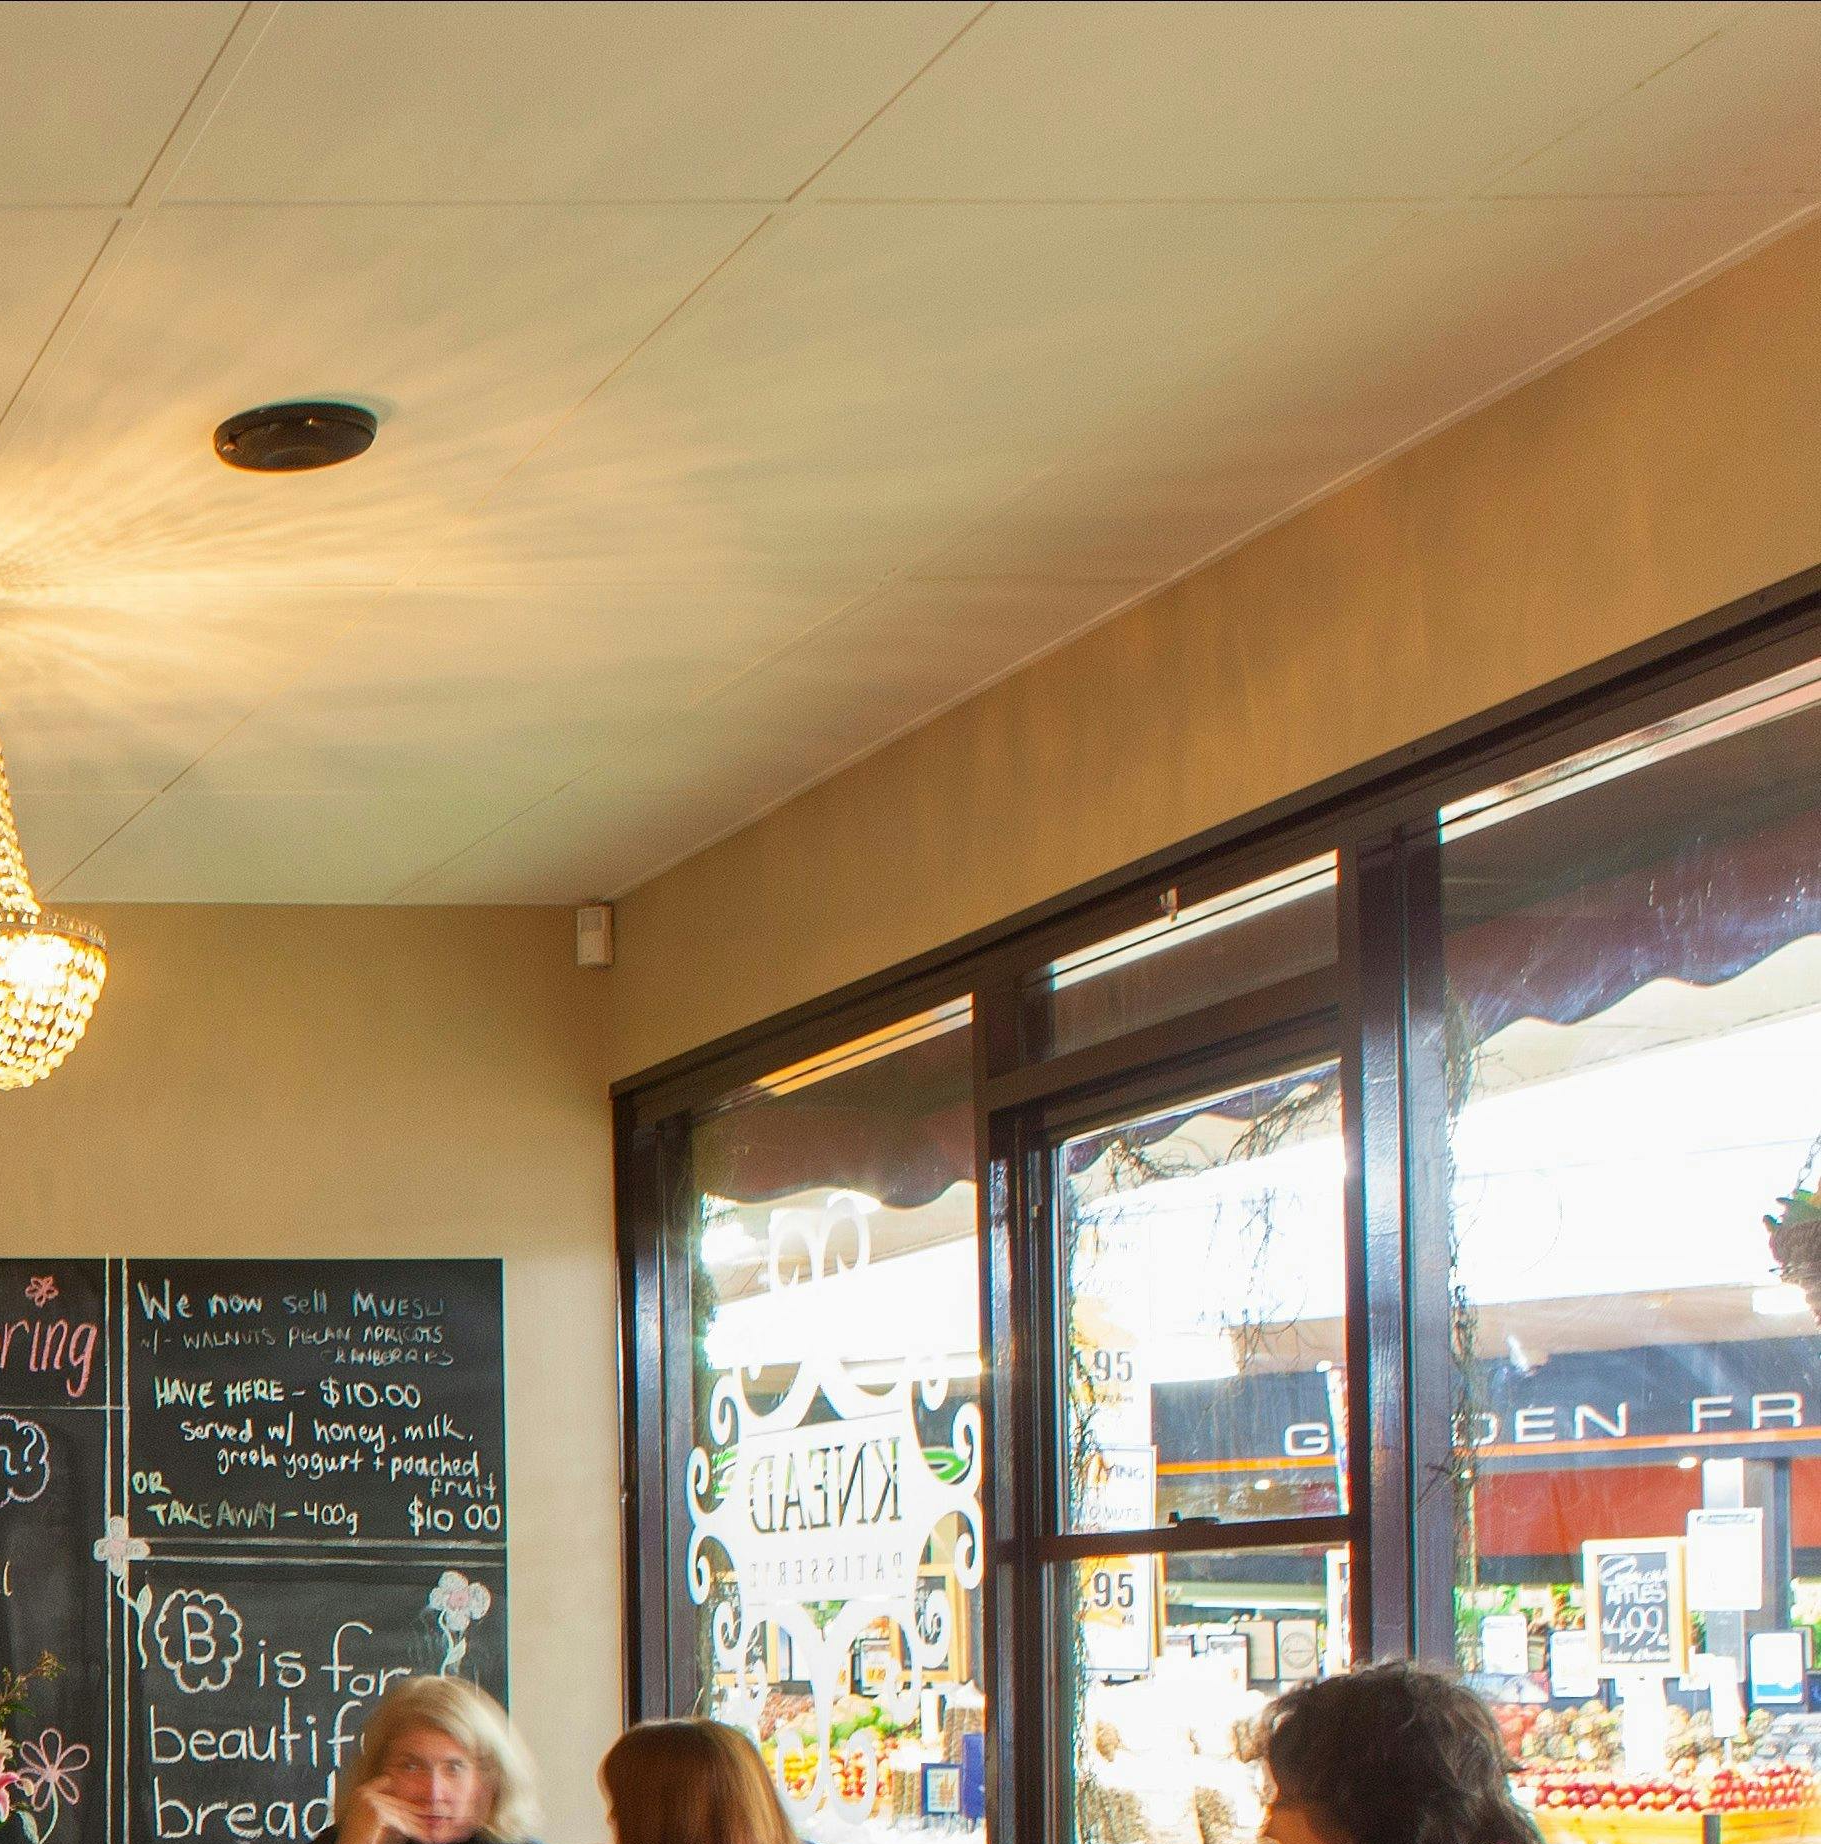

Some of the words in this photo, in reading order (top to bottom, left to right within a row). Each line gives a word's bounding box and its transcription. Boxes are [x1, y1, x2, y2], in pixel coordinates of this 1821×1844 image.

[137, 1278, 193, 1322] We
[210, 1292, 263, 1316] now
[283, 1289, 328, 1316] sell
[154, 1376, 214, 1409] HAVE
[224, 1377, 284, 1406] HERE
[320, 1375, 421, 1409] $10.00
[180, 1418, 254, 1445] served
[283, 1448, 364, 1480] yogurt
[390, 1451, 481, 1482] poached
[132, 1471, 172, 1495] OR
[430, 1478, 498, 1500] fruit
[145, 1502, 213, 1530] TAKE
[216, 1501, 276, 1530] AWAY
[181, 1604, 218, 1665] B
[256, 1639, 307, 1689] is
[320, 1620, 413, 1698] for
[150, 1696, 366, 1768] beautif
[153, 1770, 338, 1840] bread
